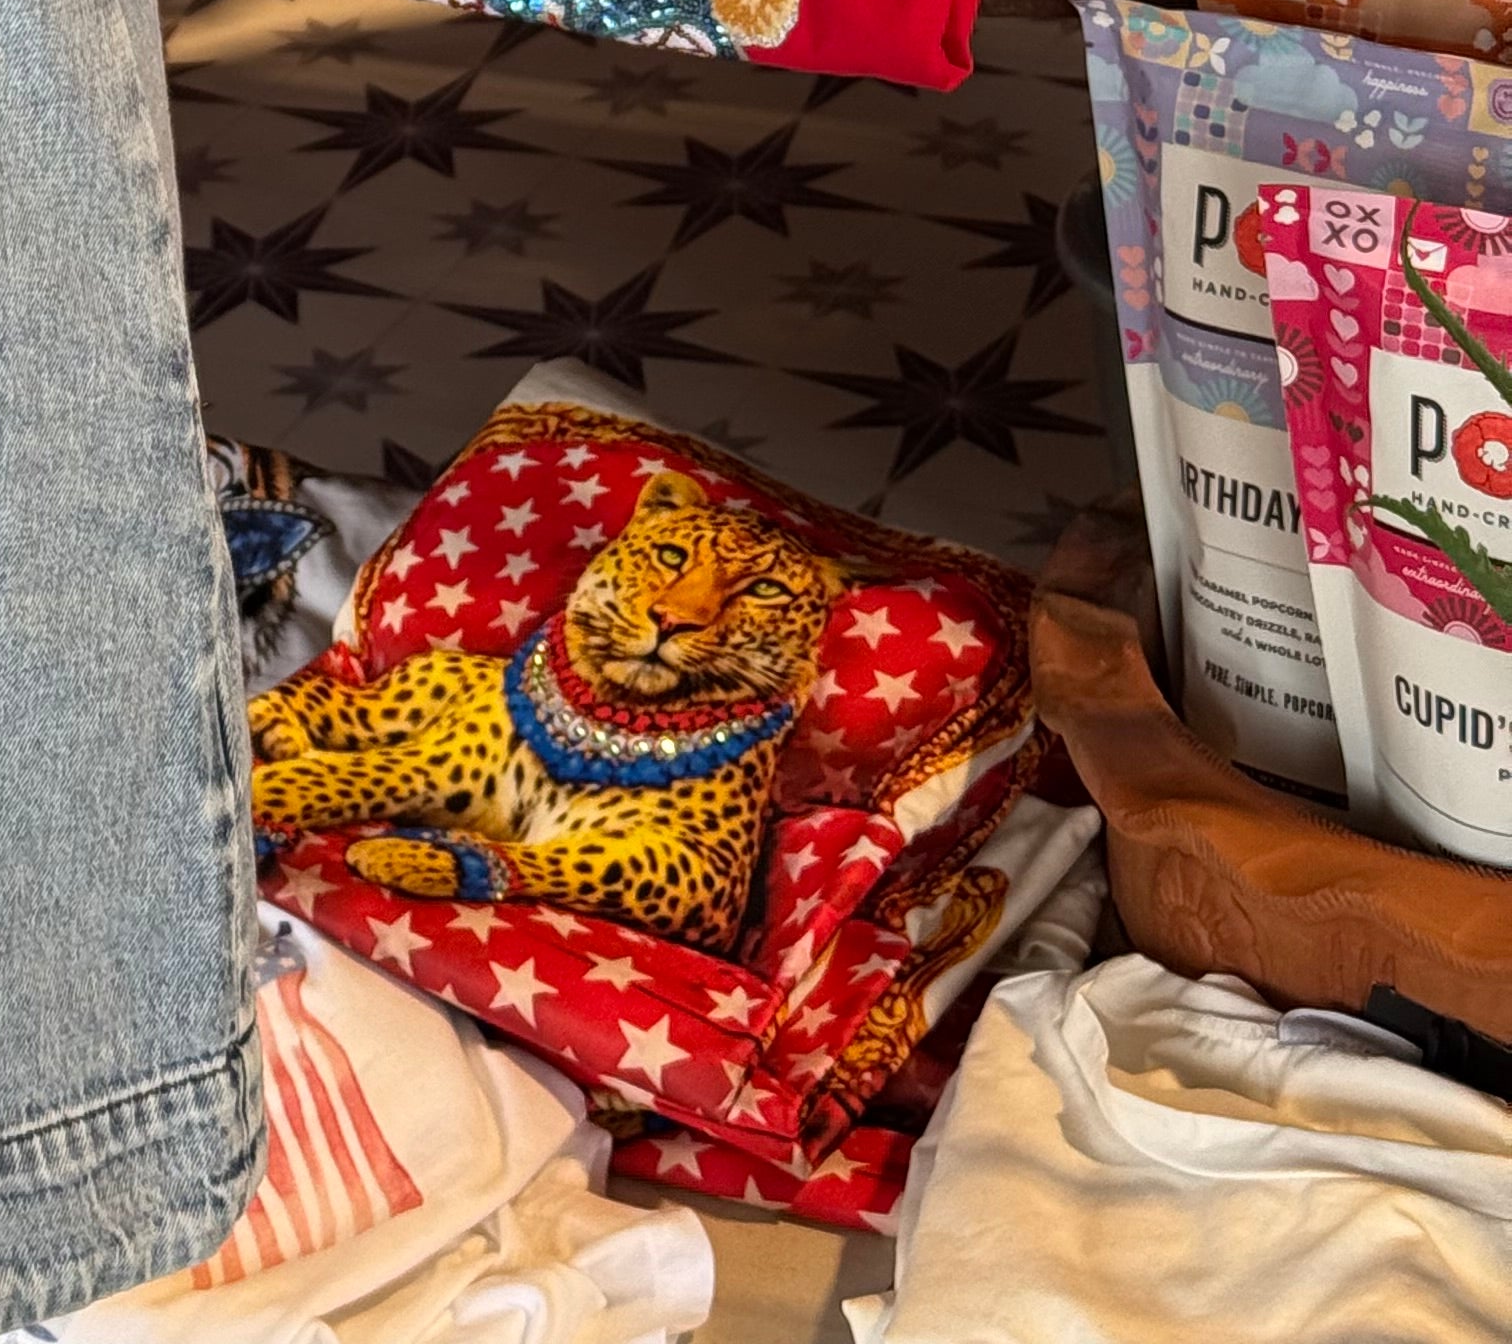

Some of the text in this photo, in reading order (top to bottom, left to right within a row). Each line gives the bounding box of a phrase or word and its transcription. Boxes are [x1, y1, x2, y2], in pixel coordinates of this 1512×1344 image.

[1324, 199, 1382, 227] OX
[1321, 220, 1380, 254] XO
[1254, 639, 1302, 661] WHOLE
